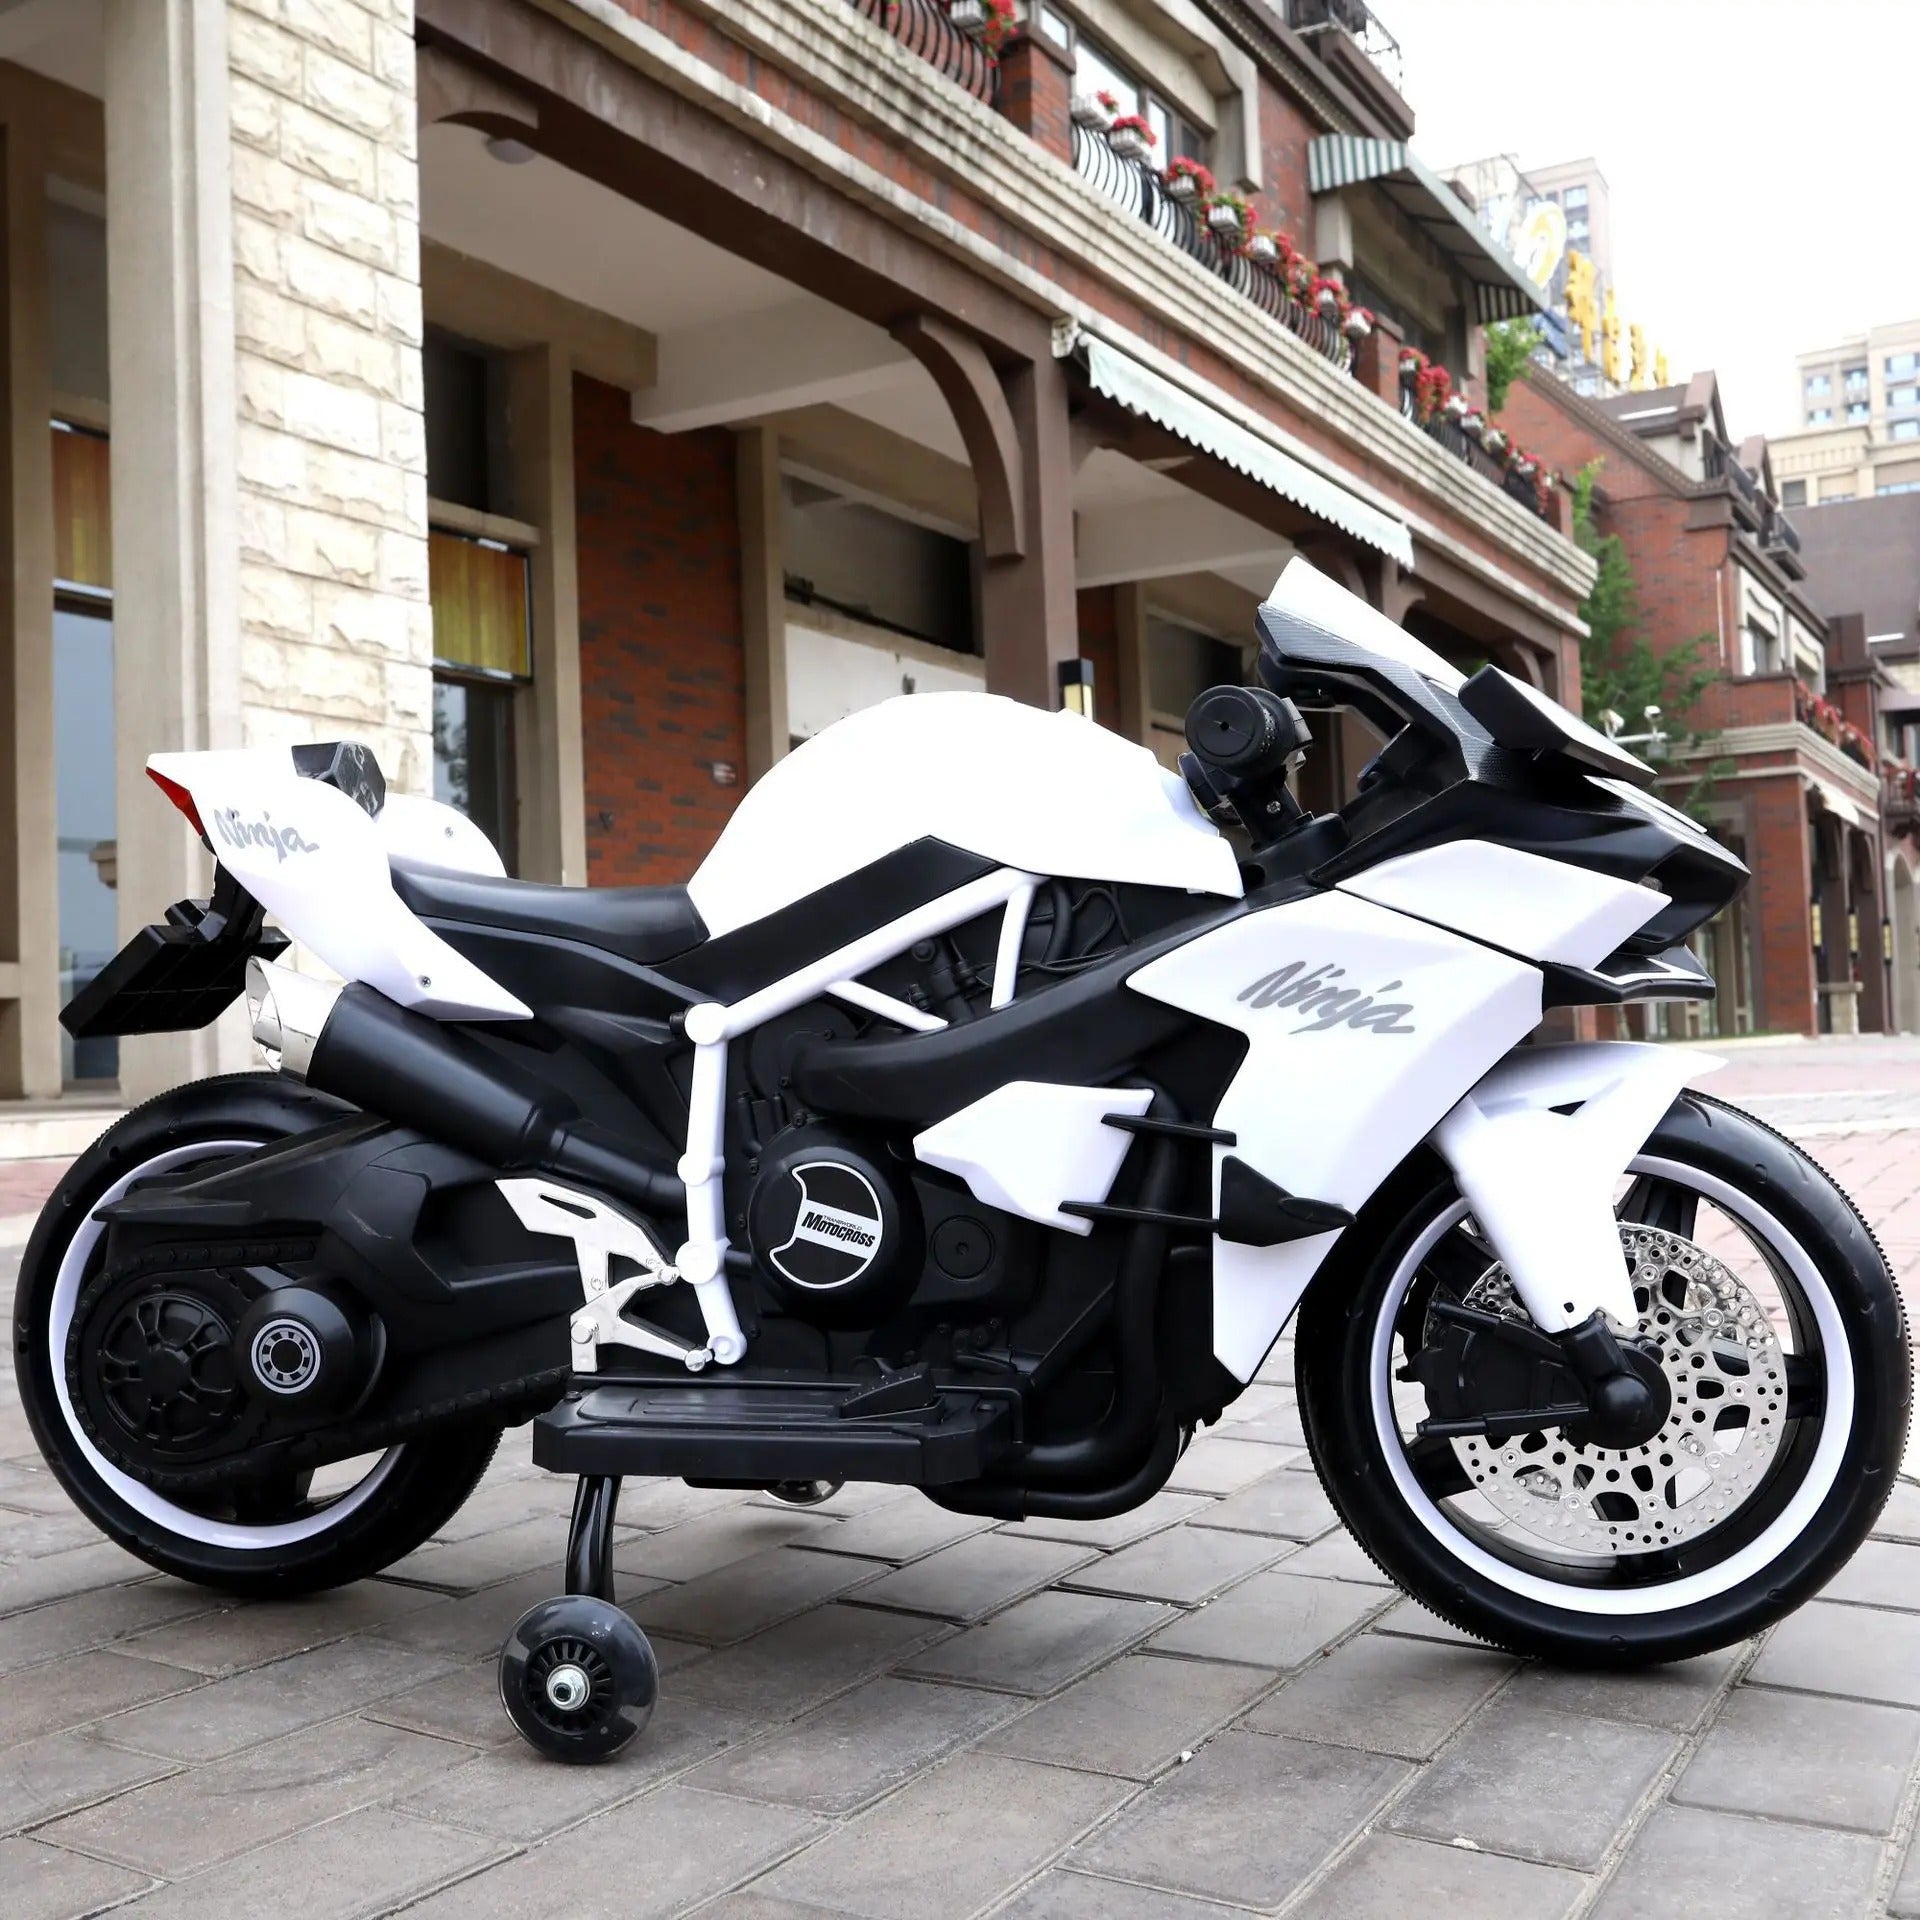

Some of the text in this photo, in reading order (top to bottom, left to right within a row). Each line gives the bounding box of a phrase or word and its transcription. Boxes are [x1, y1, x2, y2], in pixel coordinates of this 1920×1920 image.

[213, 807, 320, 864] Ninja
[1236, 961, 1415, 1035] Ninja
[801, 1211, 876, 1247] MOTOCROSS
